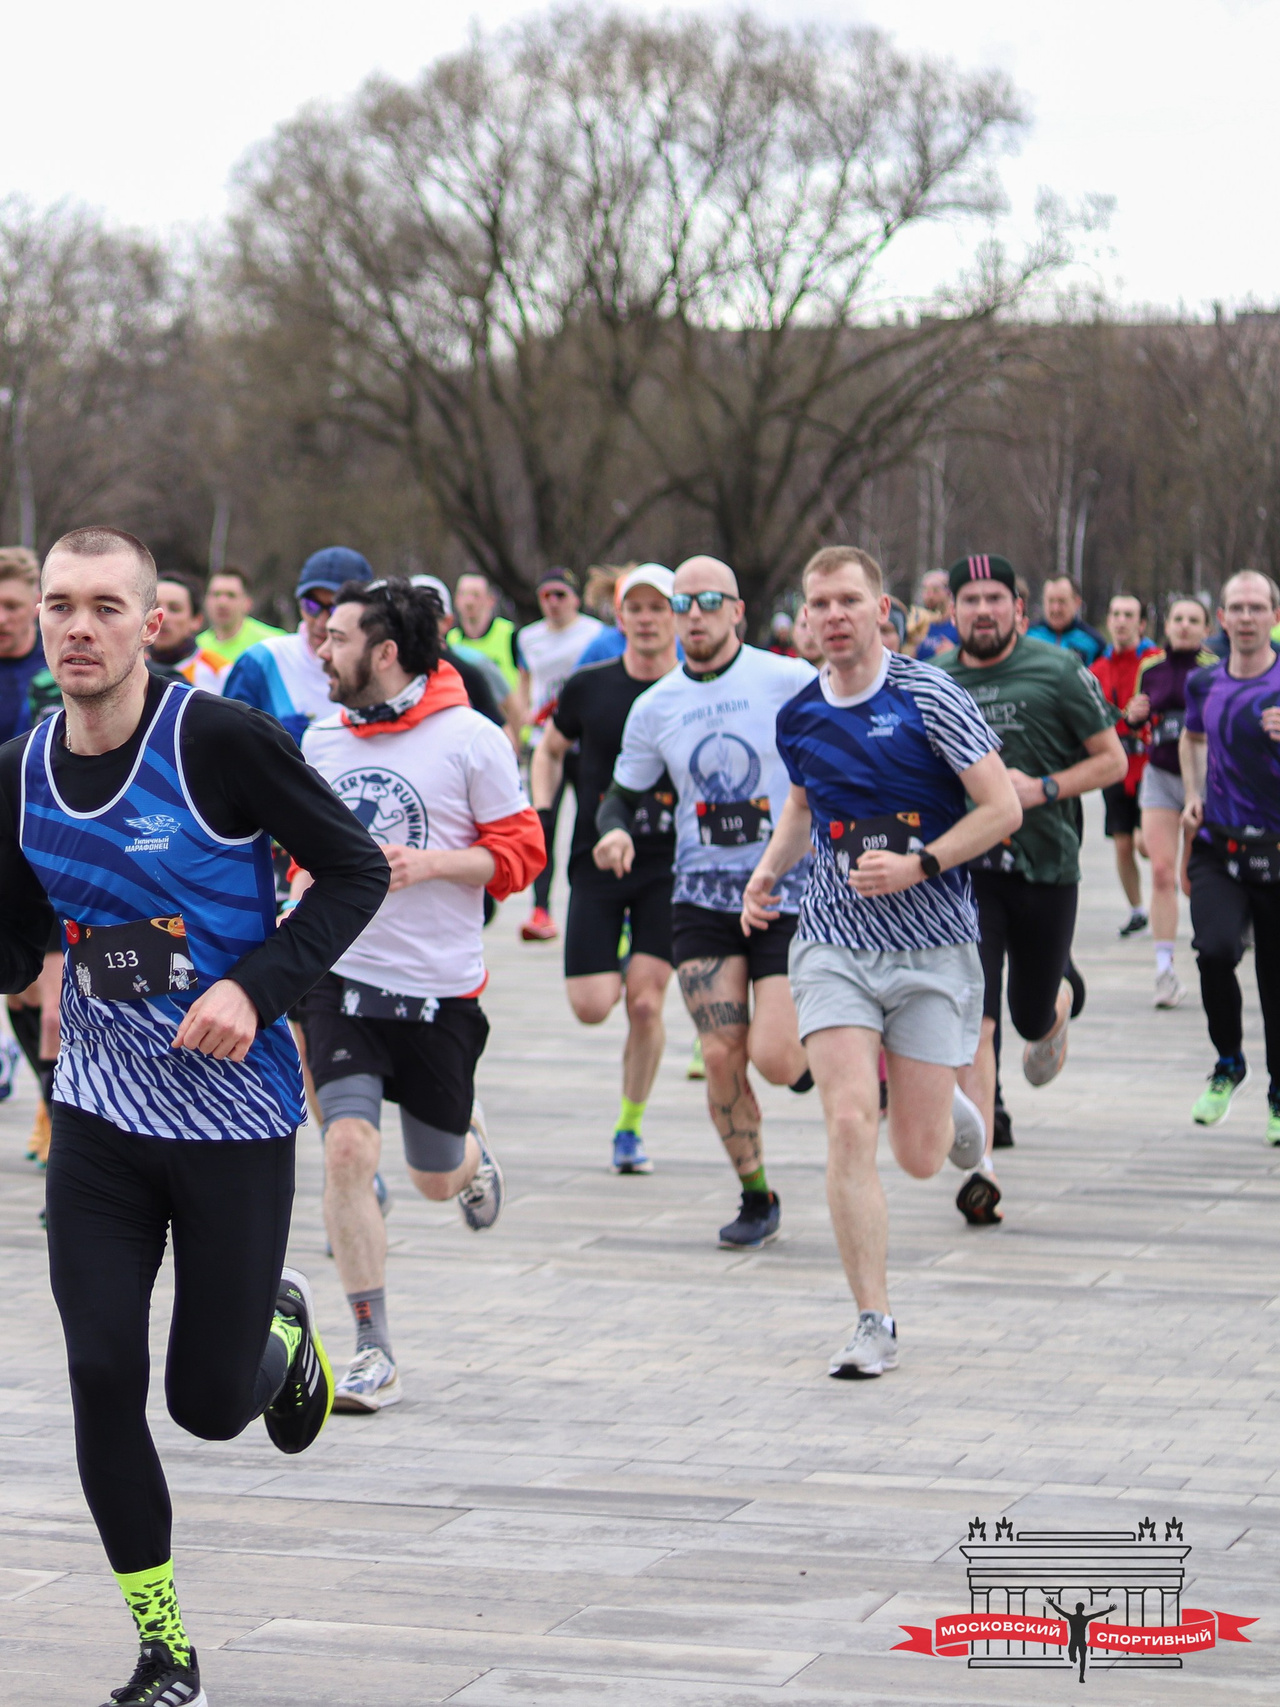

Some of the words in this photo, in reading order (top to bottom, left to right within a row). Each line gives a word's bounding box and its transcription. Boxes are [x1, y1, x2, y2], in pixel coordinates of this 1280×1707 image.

[720, 815, 744, 832] 110
[862, 833, 888, 851] 089
[104, 950, 139, 969] 133
